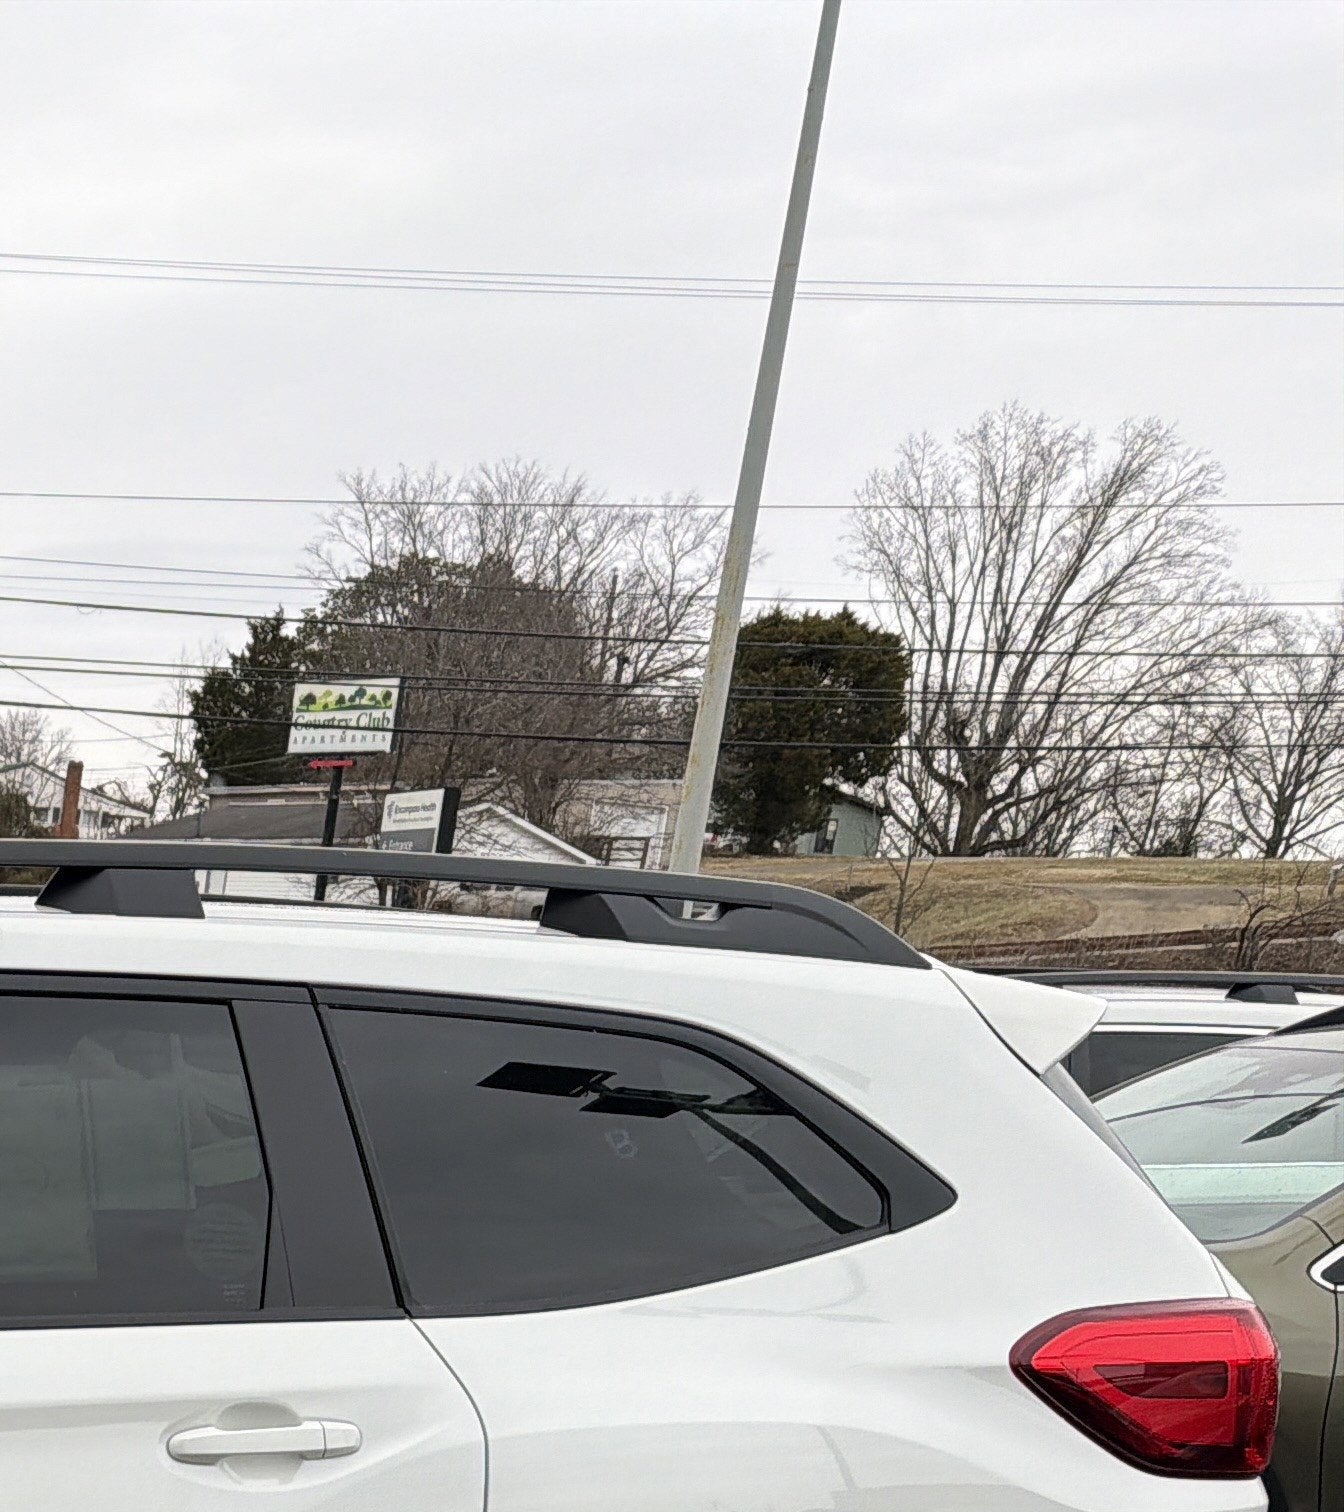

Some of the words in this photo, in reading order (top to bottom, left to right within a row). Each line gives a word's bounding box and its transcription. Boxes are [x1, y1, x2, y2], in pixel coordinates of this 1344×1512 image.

[294, 713, 353, 731] Country
[355, 710, 391, 729] Club
[293, 733, 388, 745] APARTMENTS
